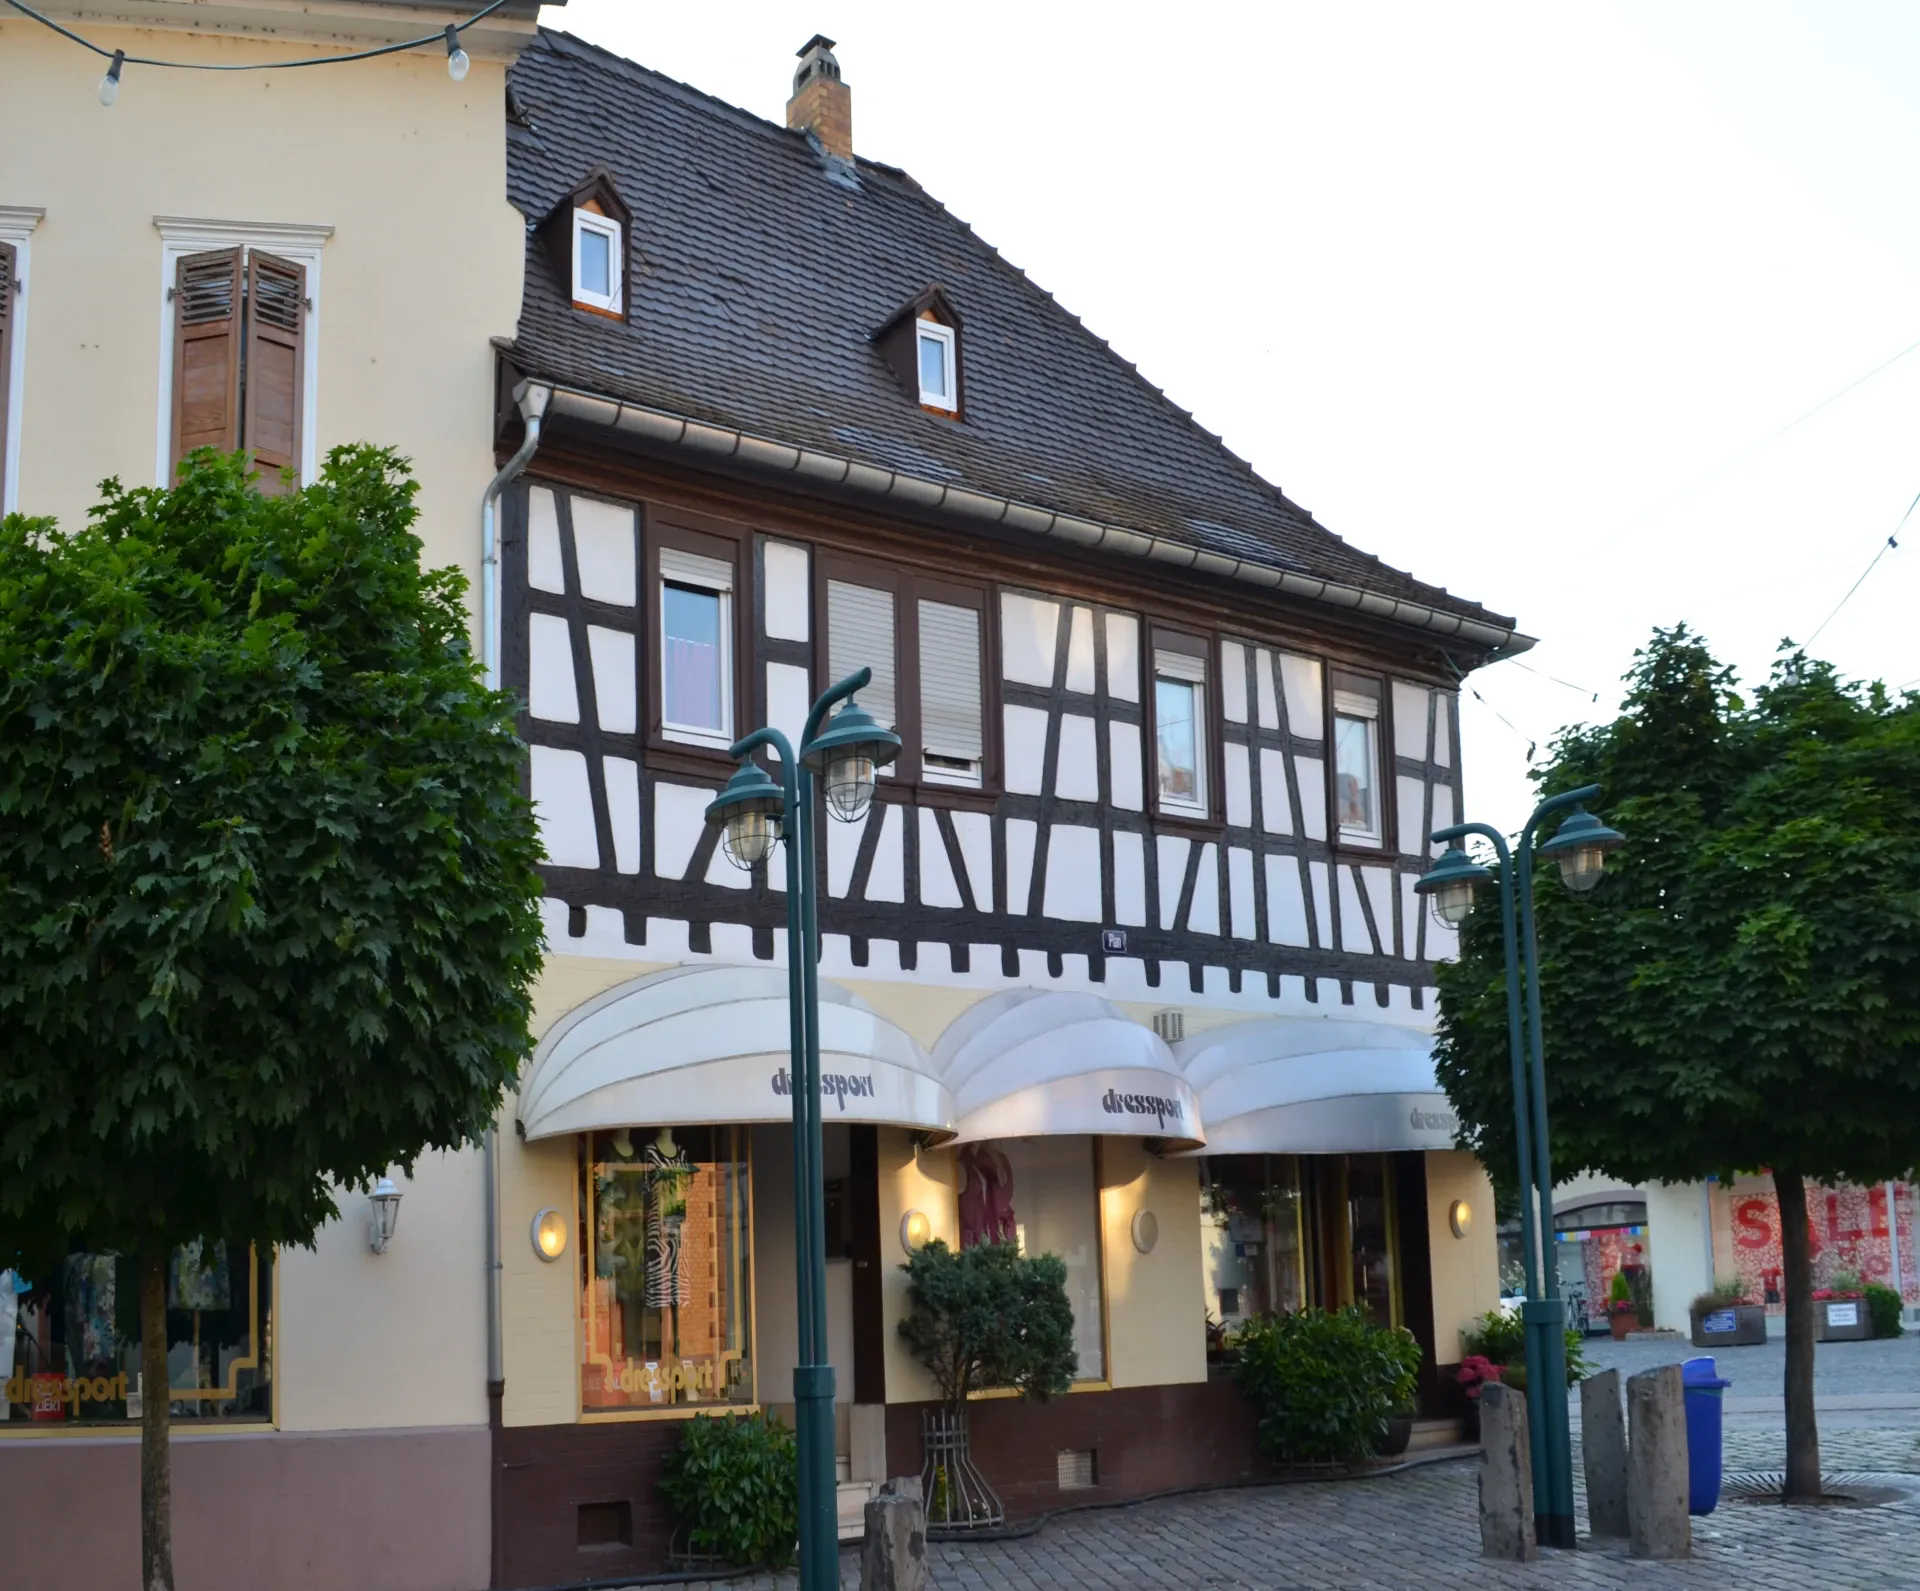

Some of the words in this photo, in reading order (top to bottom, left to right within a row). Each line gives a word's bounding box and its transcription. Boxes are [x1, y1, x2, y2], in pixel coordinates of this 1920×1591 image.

[771, 1067, 875, 1112] drsport
[1102, 1087, 1184, 1130] dressport
[1737, 1186, 1914, 1249] SLE
[5, 1364, 129, 1417] dressport
[620, 1356, 713, 1404] dressport
